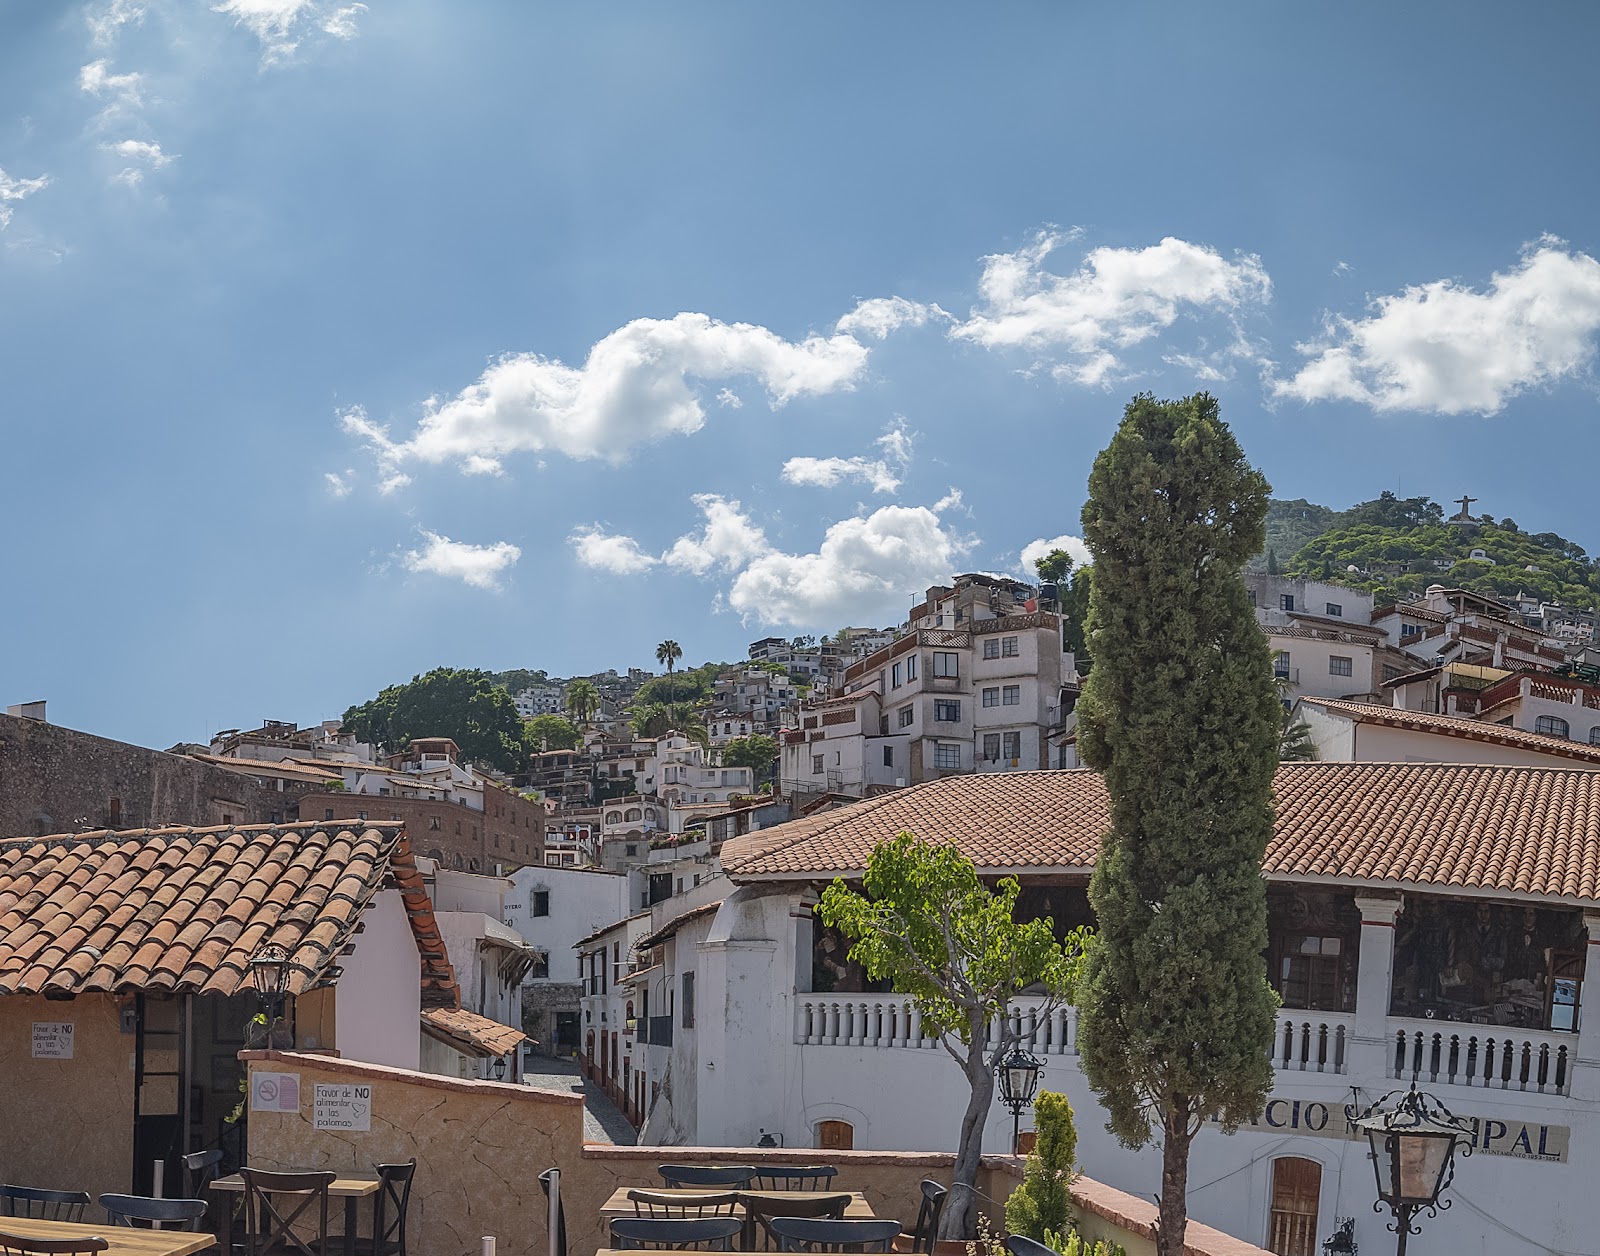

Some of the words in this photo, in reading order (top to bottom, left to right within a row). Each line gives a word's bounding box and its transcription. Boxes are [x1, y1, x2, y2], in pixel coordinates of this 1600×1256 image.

[33, 1024, 48, 1033] Favor
[61, 1024, 73, 1034] NO
[316, 1086, 340, 1097] Favor
[341, 1087, 352, 1098] de
[354, 1087, 370, 1099] NO
[316, 1098, 352, 1107] alimentar
[317, 1109, 323, 1117] a
[328, 1108, 340, 1118] las
[317, 1118, 352, 1128] palomas
